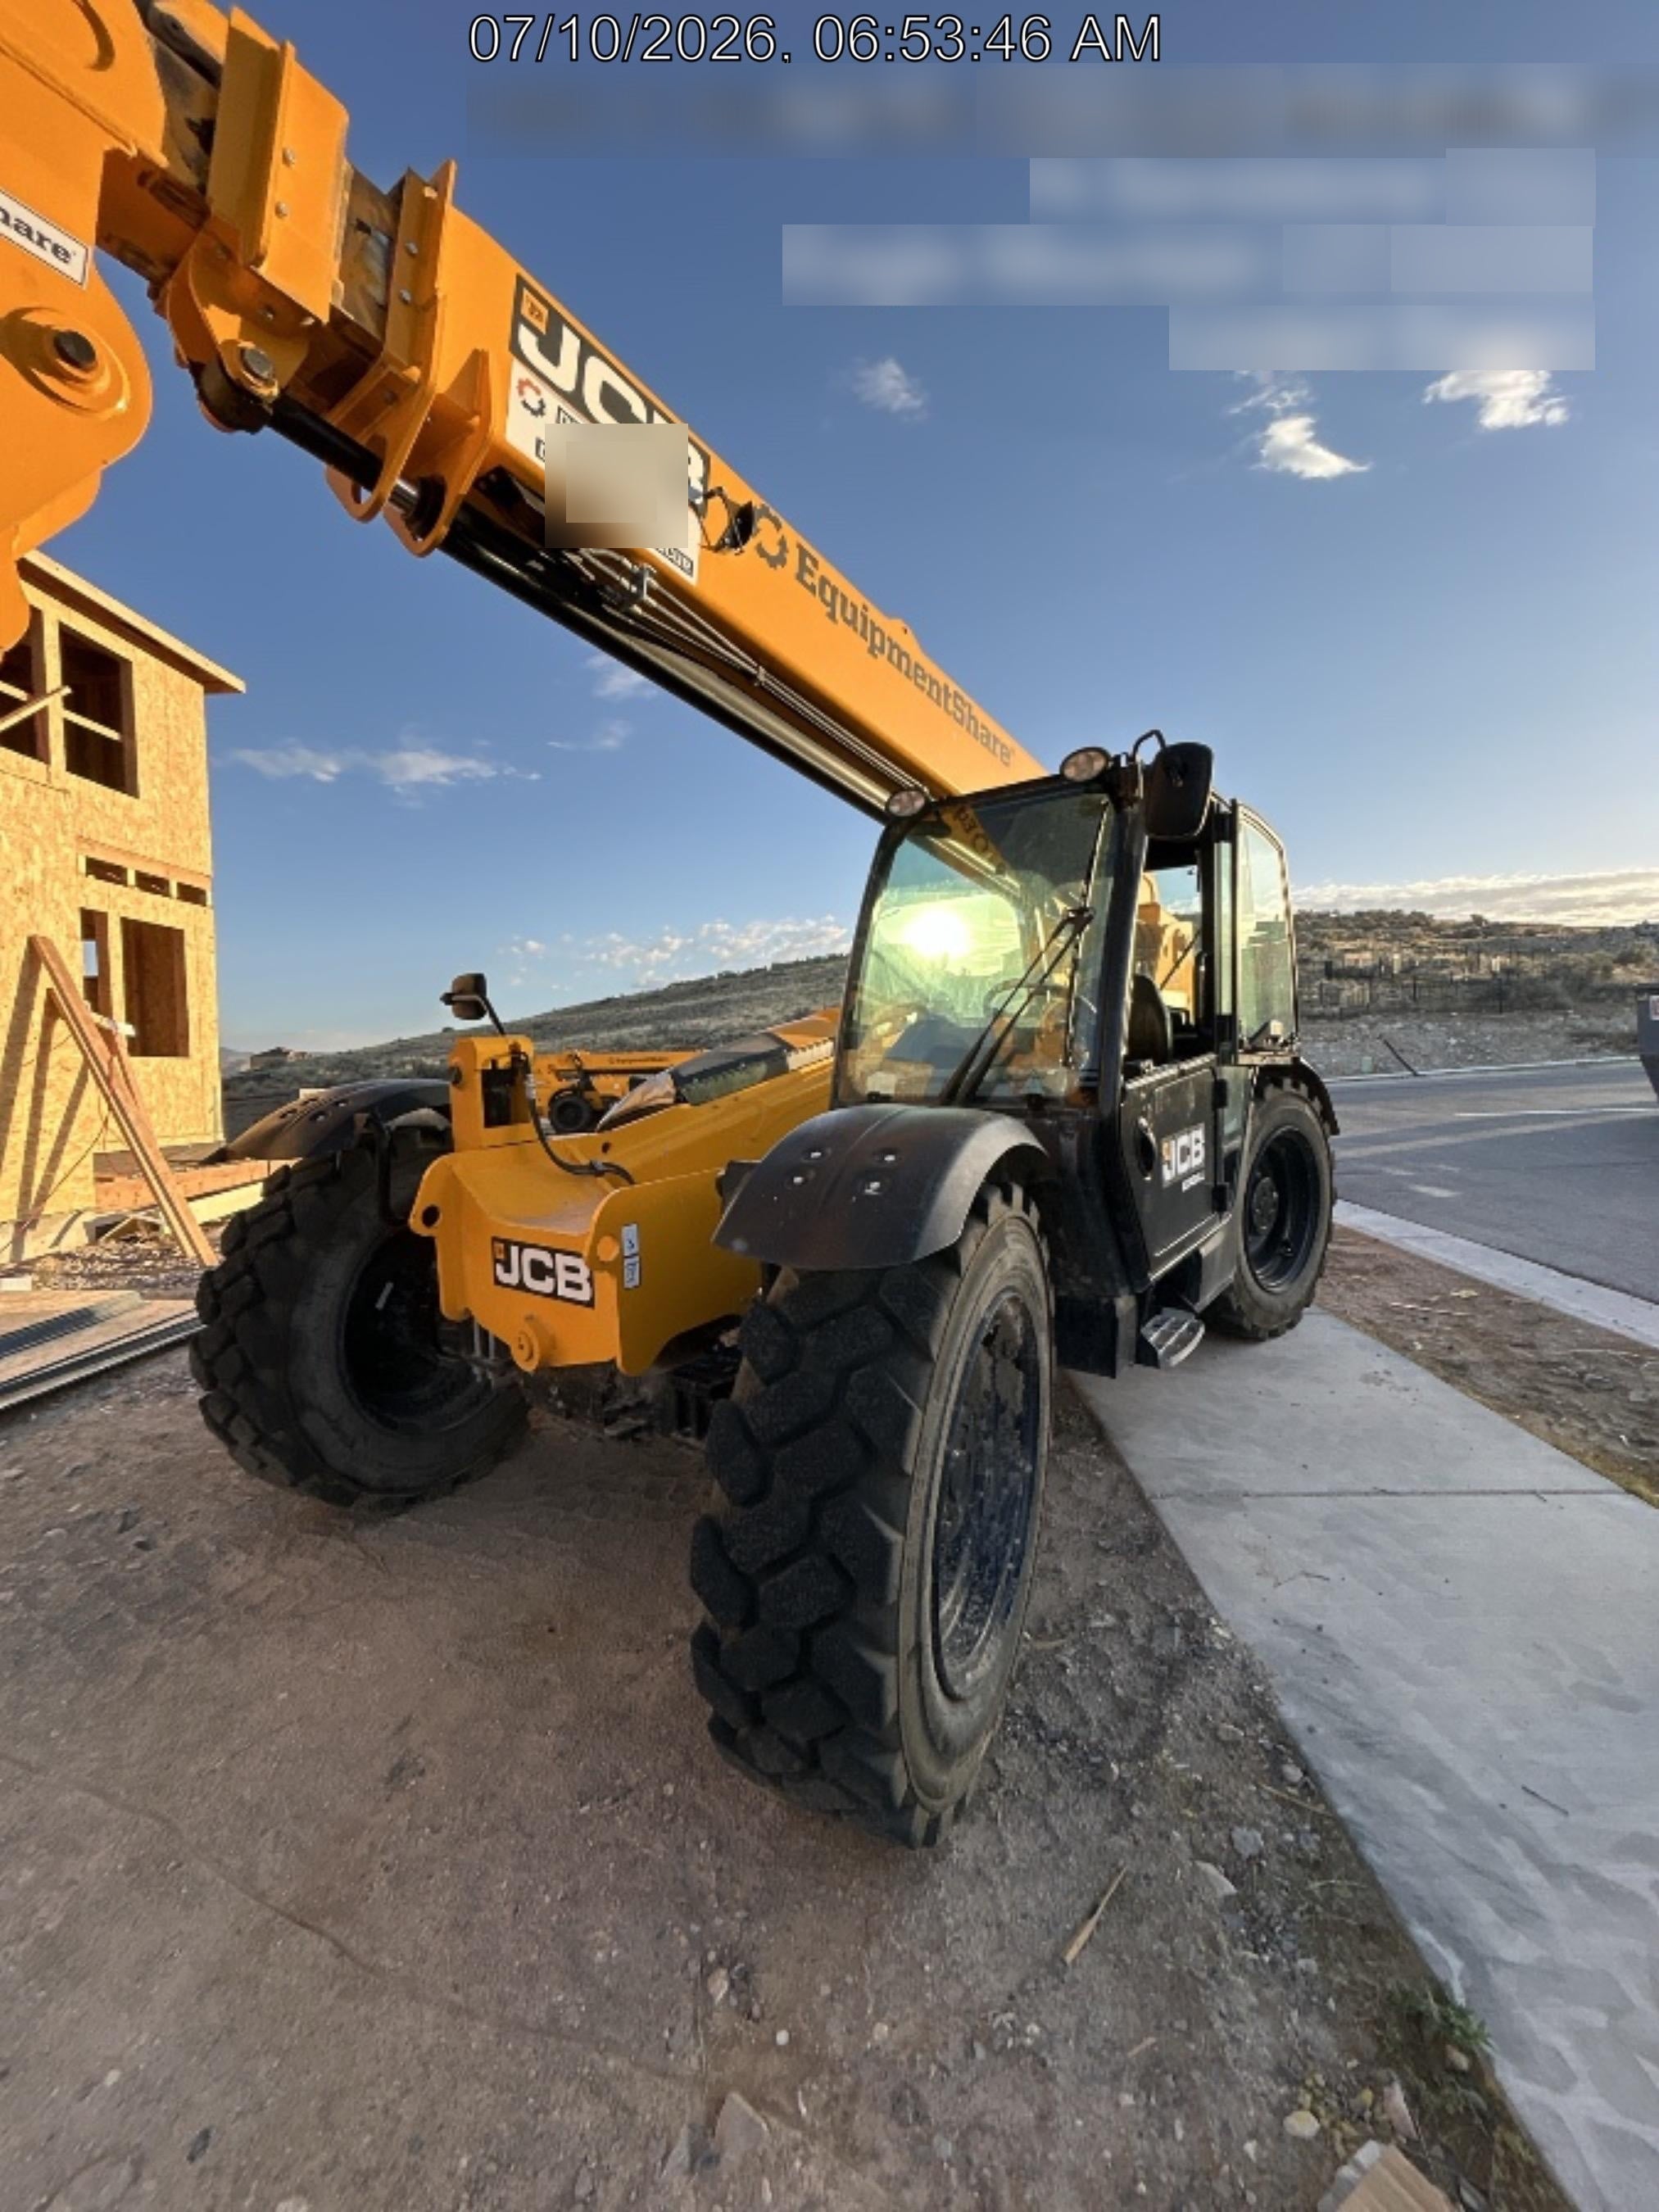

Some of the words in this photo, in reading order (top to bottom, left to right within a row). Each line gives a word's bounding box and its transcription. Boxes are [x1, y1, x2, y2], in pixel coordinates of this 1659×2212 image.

[795, 542, 1012, 767] EquipmentShare
[1162, 1128, 1205, 1181] JCB
[495, 1244, 593, 1302] JCB
